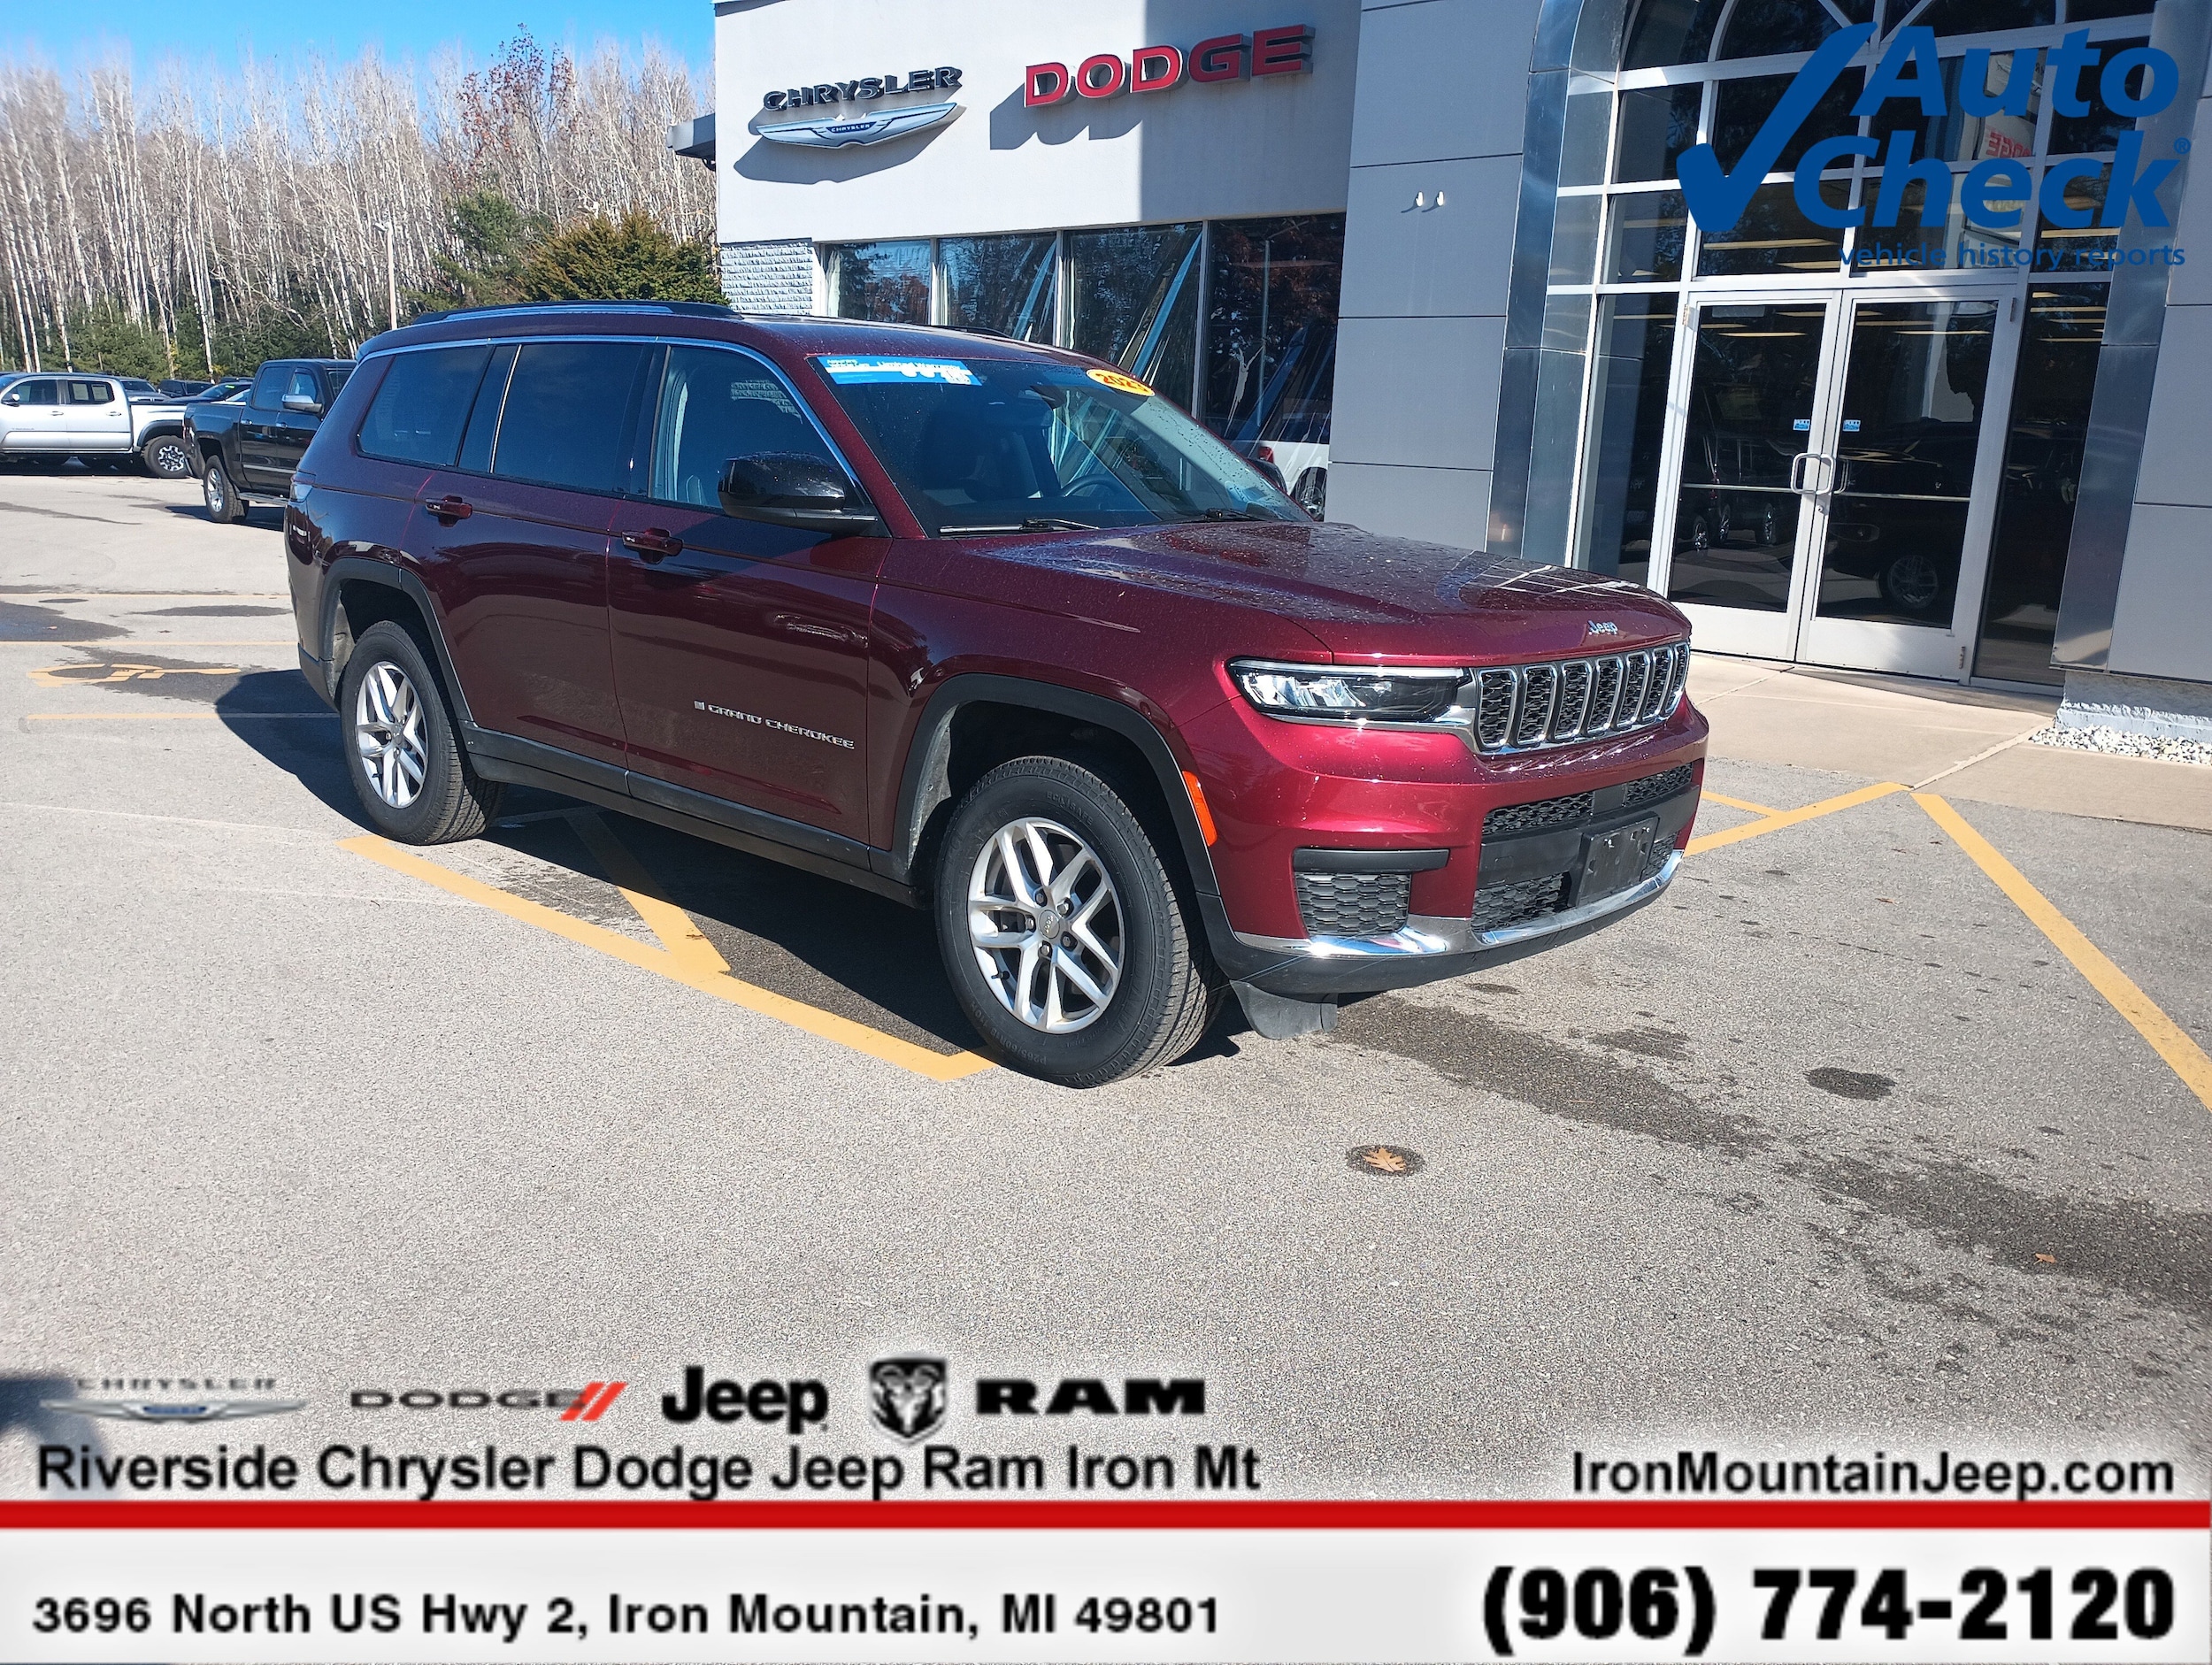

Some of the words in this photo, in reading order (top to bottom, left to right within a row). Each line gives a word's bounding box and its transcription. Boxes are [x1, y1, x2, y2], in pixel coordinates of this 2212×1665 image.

[763, 66, 961, 111] CHRYSLER
[1024, 24, 1311, 108] DODGE
[831, 123, 871, 133] CHRYSLER
[1588, 620, 1618, 634] Jeep
[708, 704, 762, 725] GRAND
[765, 718, 855, 749] CHEROKEE
